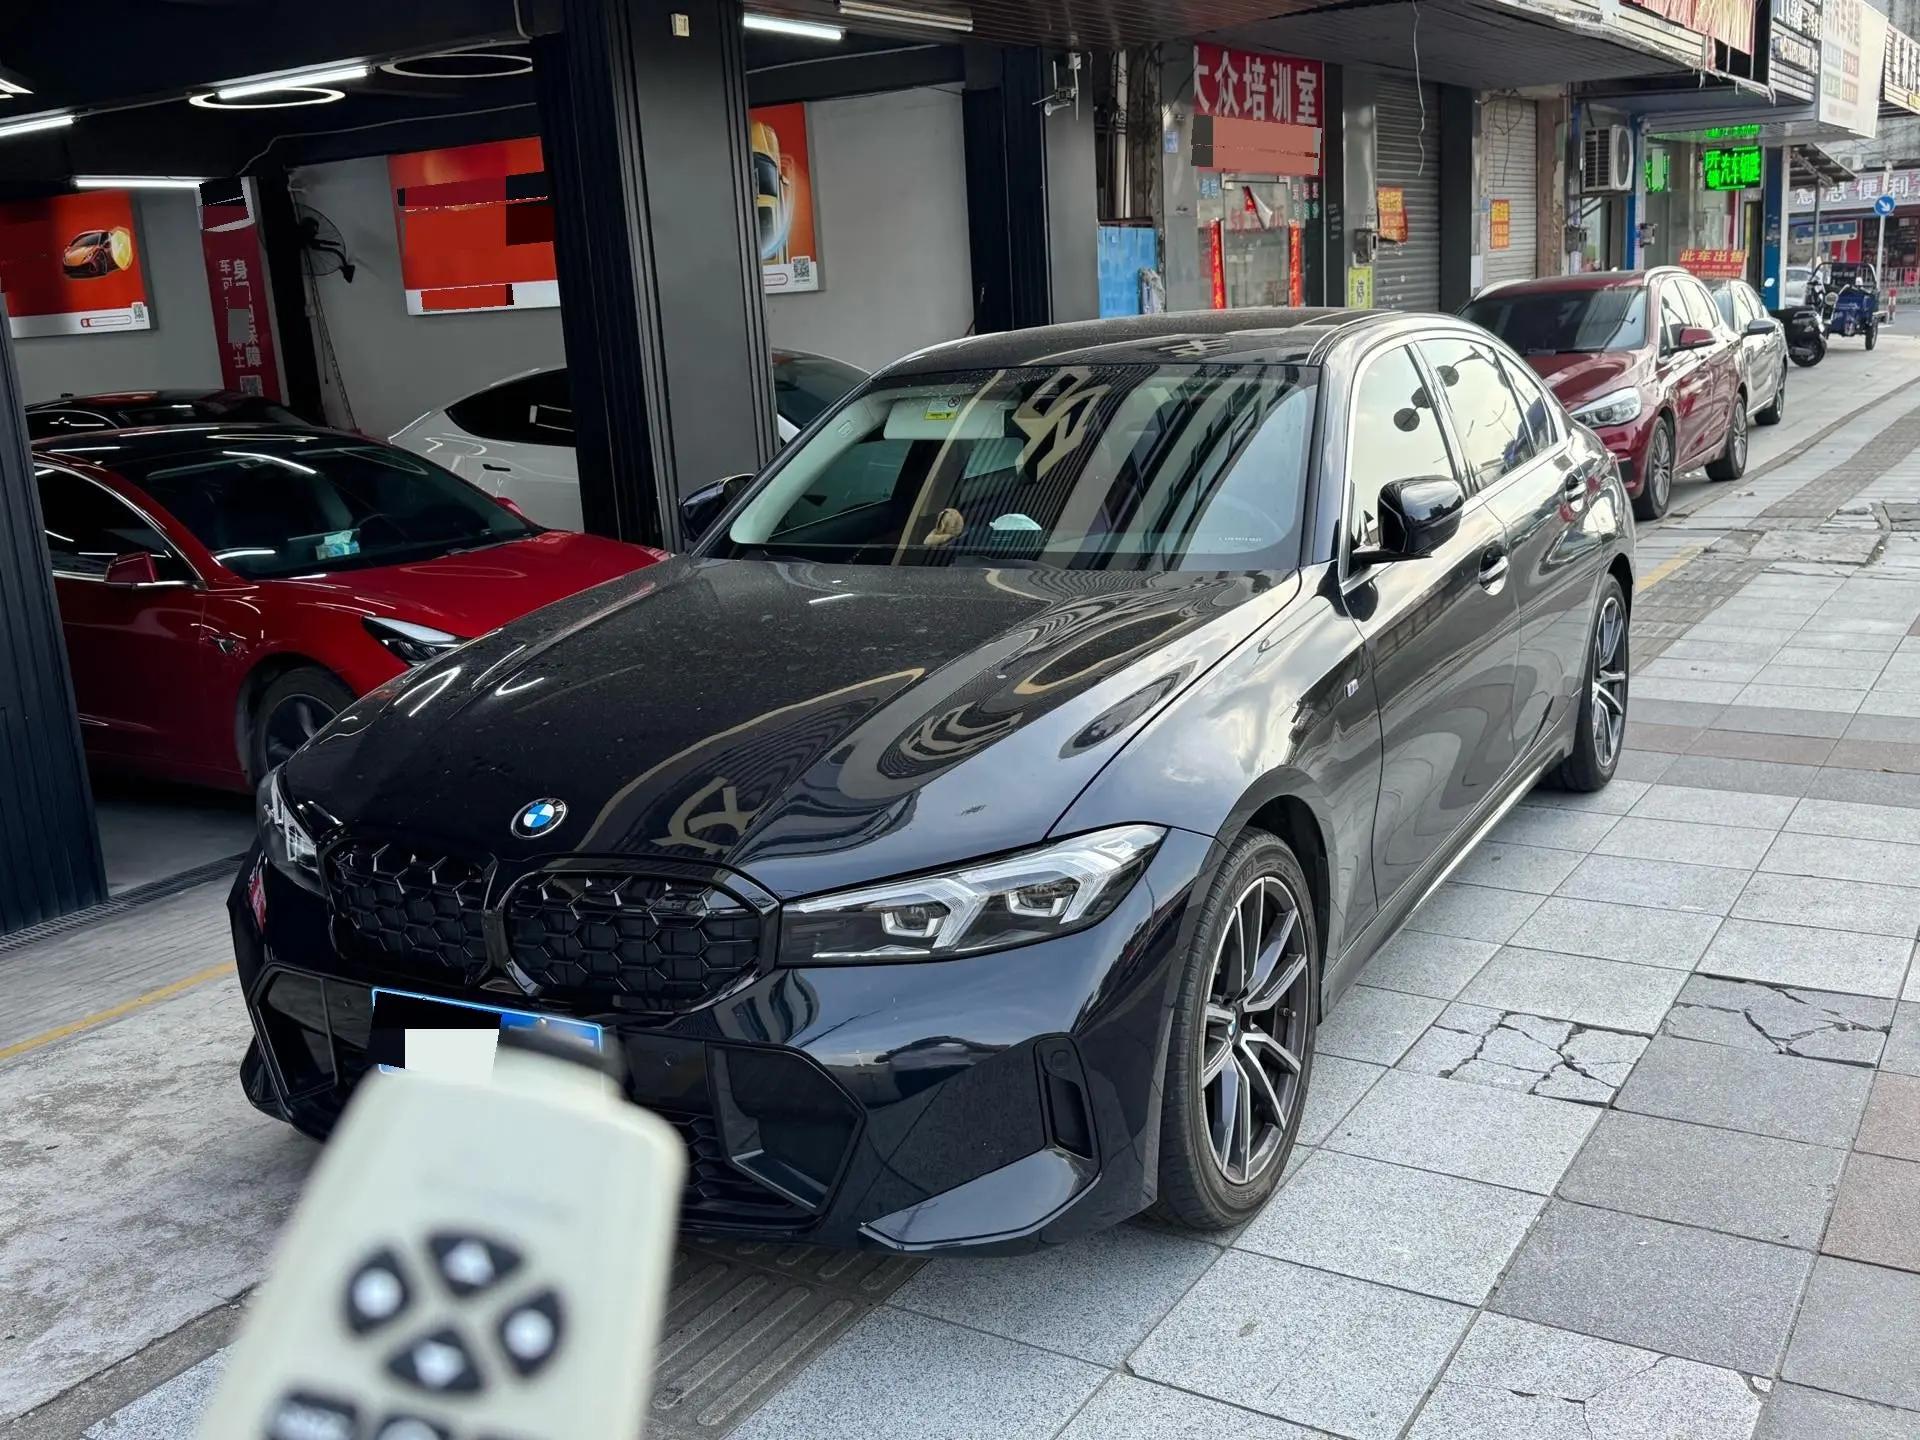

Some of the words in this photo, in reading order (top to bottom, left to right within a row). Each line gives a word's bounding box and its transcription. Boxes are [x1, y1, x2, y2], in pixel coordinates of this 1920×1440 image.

[1193, 45, 1317, 124] 大众培训室
